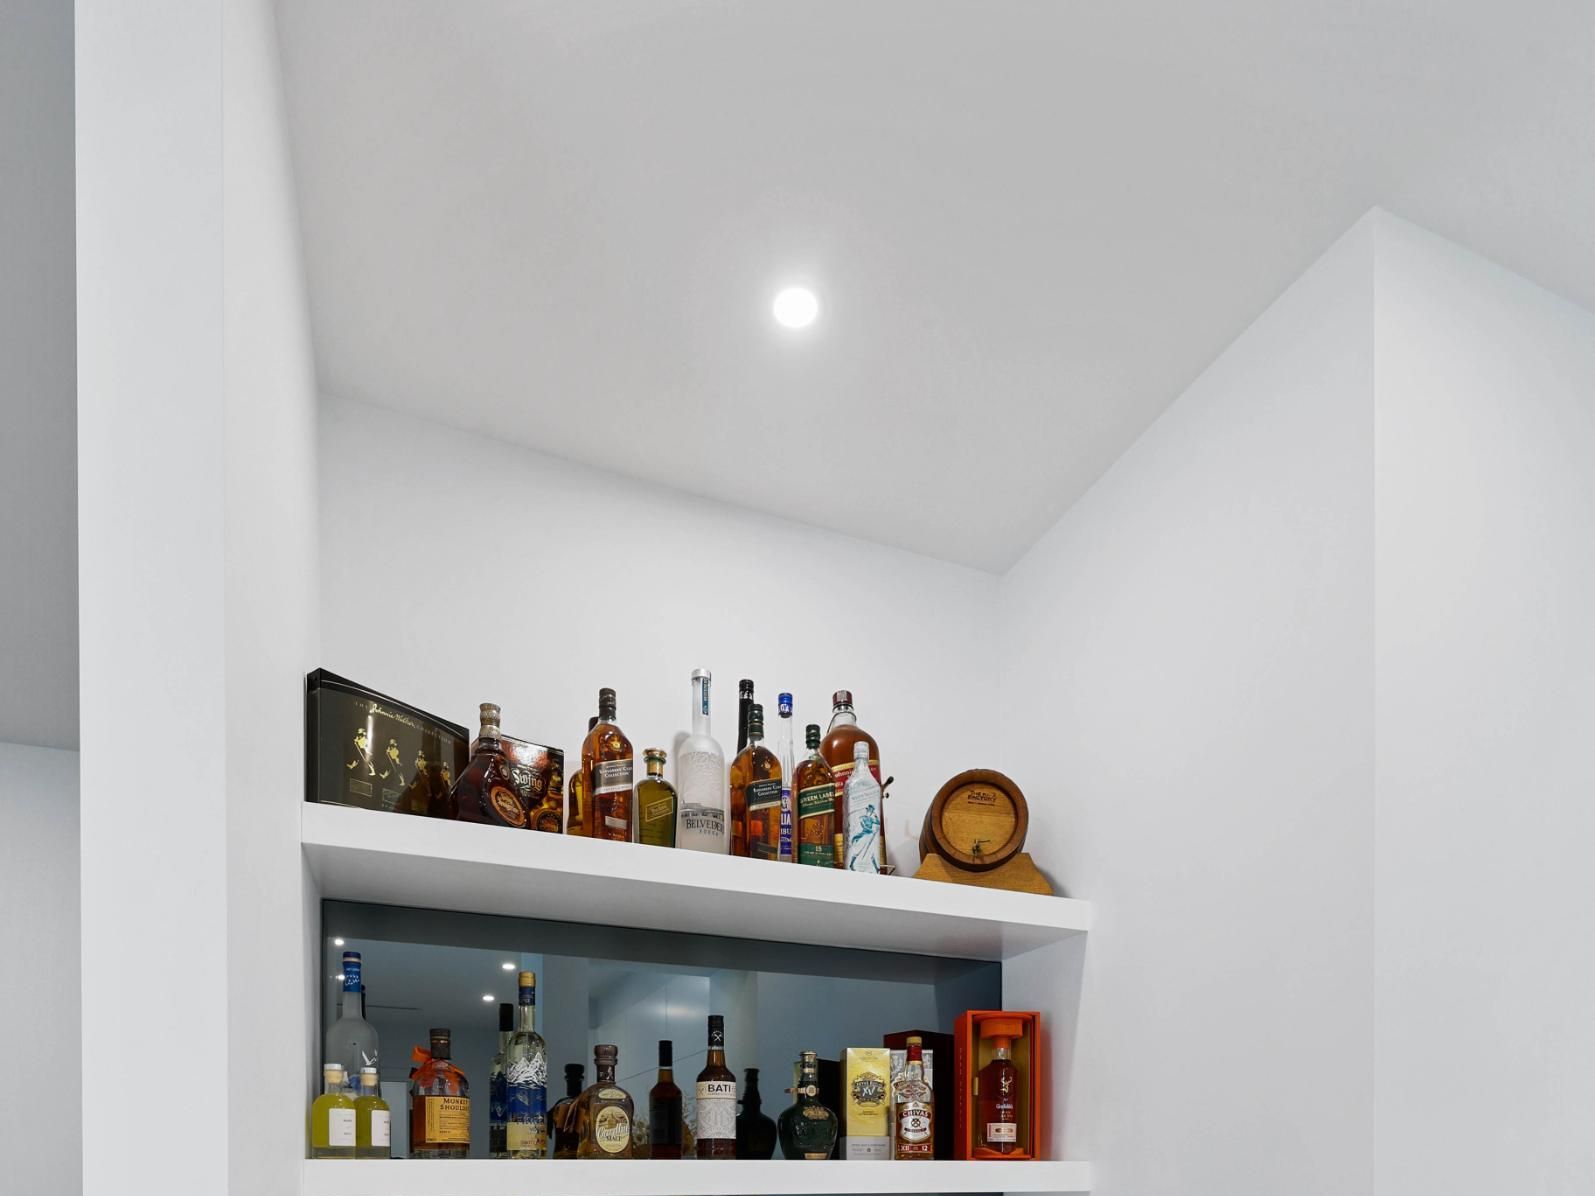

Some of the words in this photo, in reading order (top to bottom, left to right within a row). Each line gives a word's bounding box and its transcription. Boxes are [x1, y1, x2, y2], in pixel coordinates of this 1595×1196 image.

[707, 1084, 731, 1093] BATI
[862, 1086, 876, 1097] XV
[902, 1109, 929, 1117] CHIVAS
